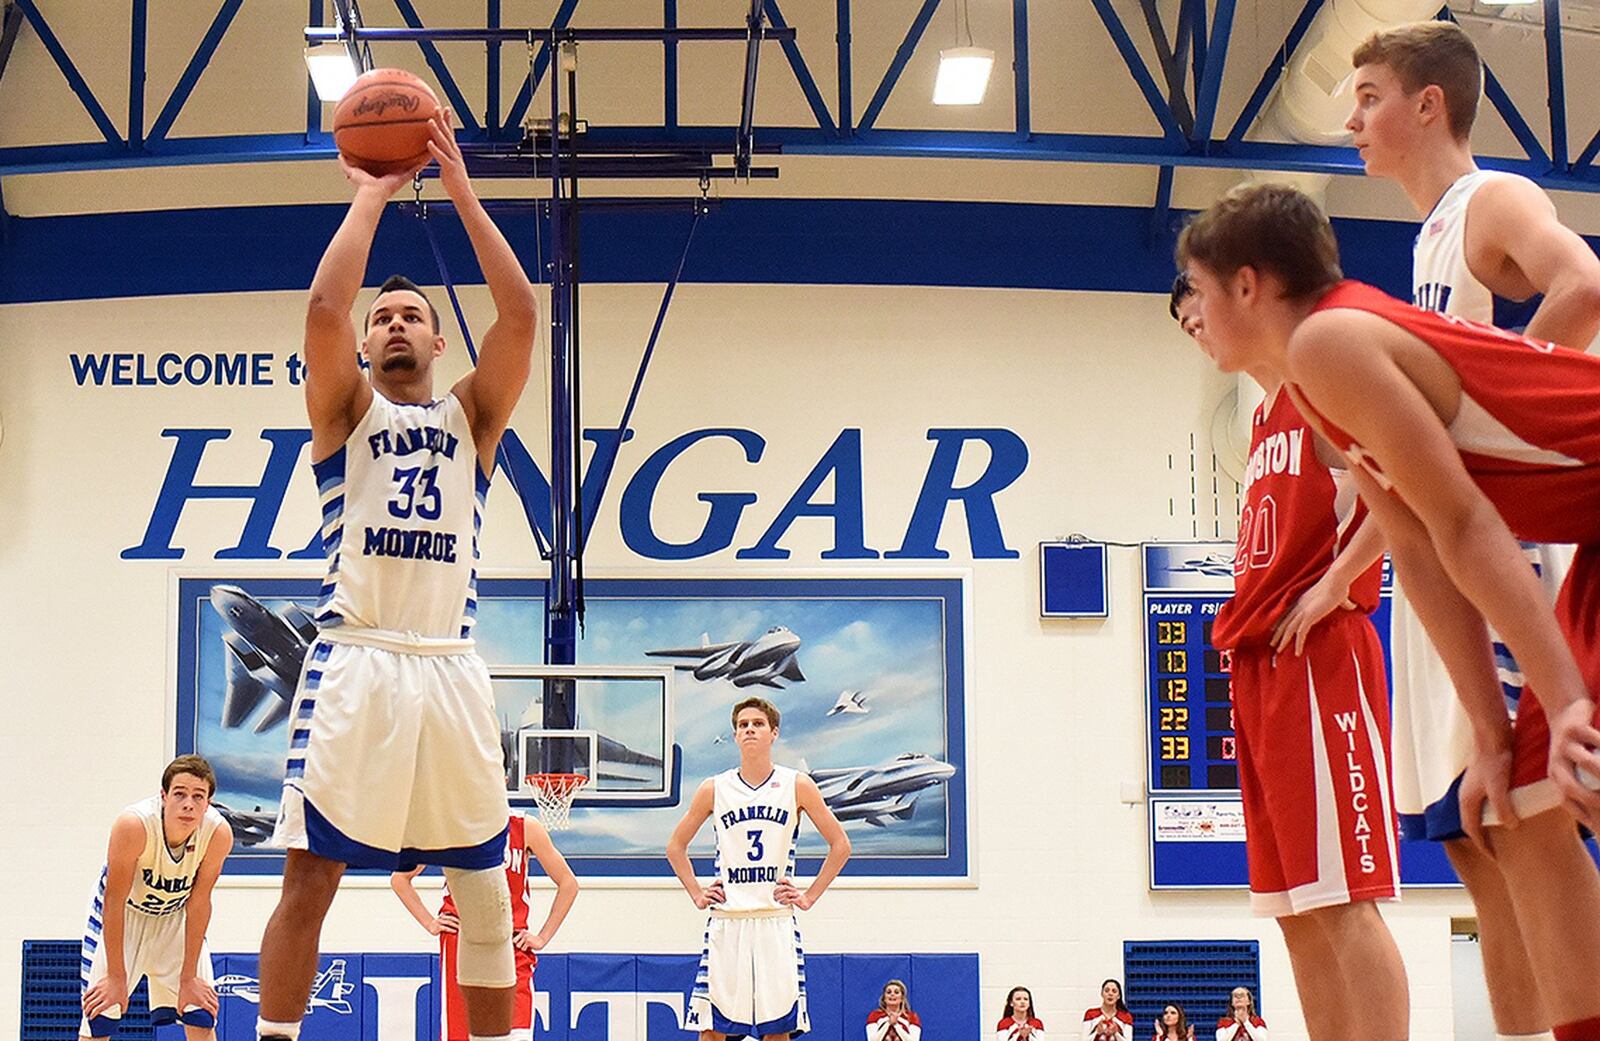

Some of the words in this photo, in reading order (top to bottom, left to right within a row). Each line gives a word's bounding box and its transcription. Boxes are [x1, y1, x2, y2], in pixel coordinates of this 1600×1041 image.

[70, 353, 274, 386] WELCOME
[286, 352, 307, 385] t
[119, 428, 1030, 559] HNGAR
[387, 466, 442, 520] 33
[363, 527, 457, 563] MONROE
[1233, 495, 1277, 576] 20
[1149, 603, 1193, 615] PLAYER
[1158, 621, 1185, 643] 03
[1167, 650, 1187, 672] 10
[1168, 679, 1187, 701] 12
[1160, 708, 1188, 730] 22
[1161, 736, 1189, 759] 33
[1222, 737, 1236, 759] 0
[1333, 711, 1376, 873] WILDCATS
[720, 806, 789, 829] FRANKLIN
[746, 830, 764, 861] 3
